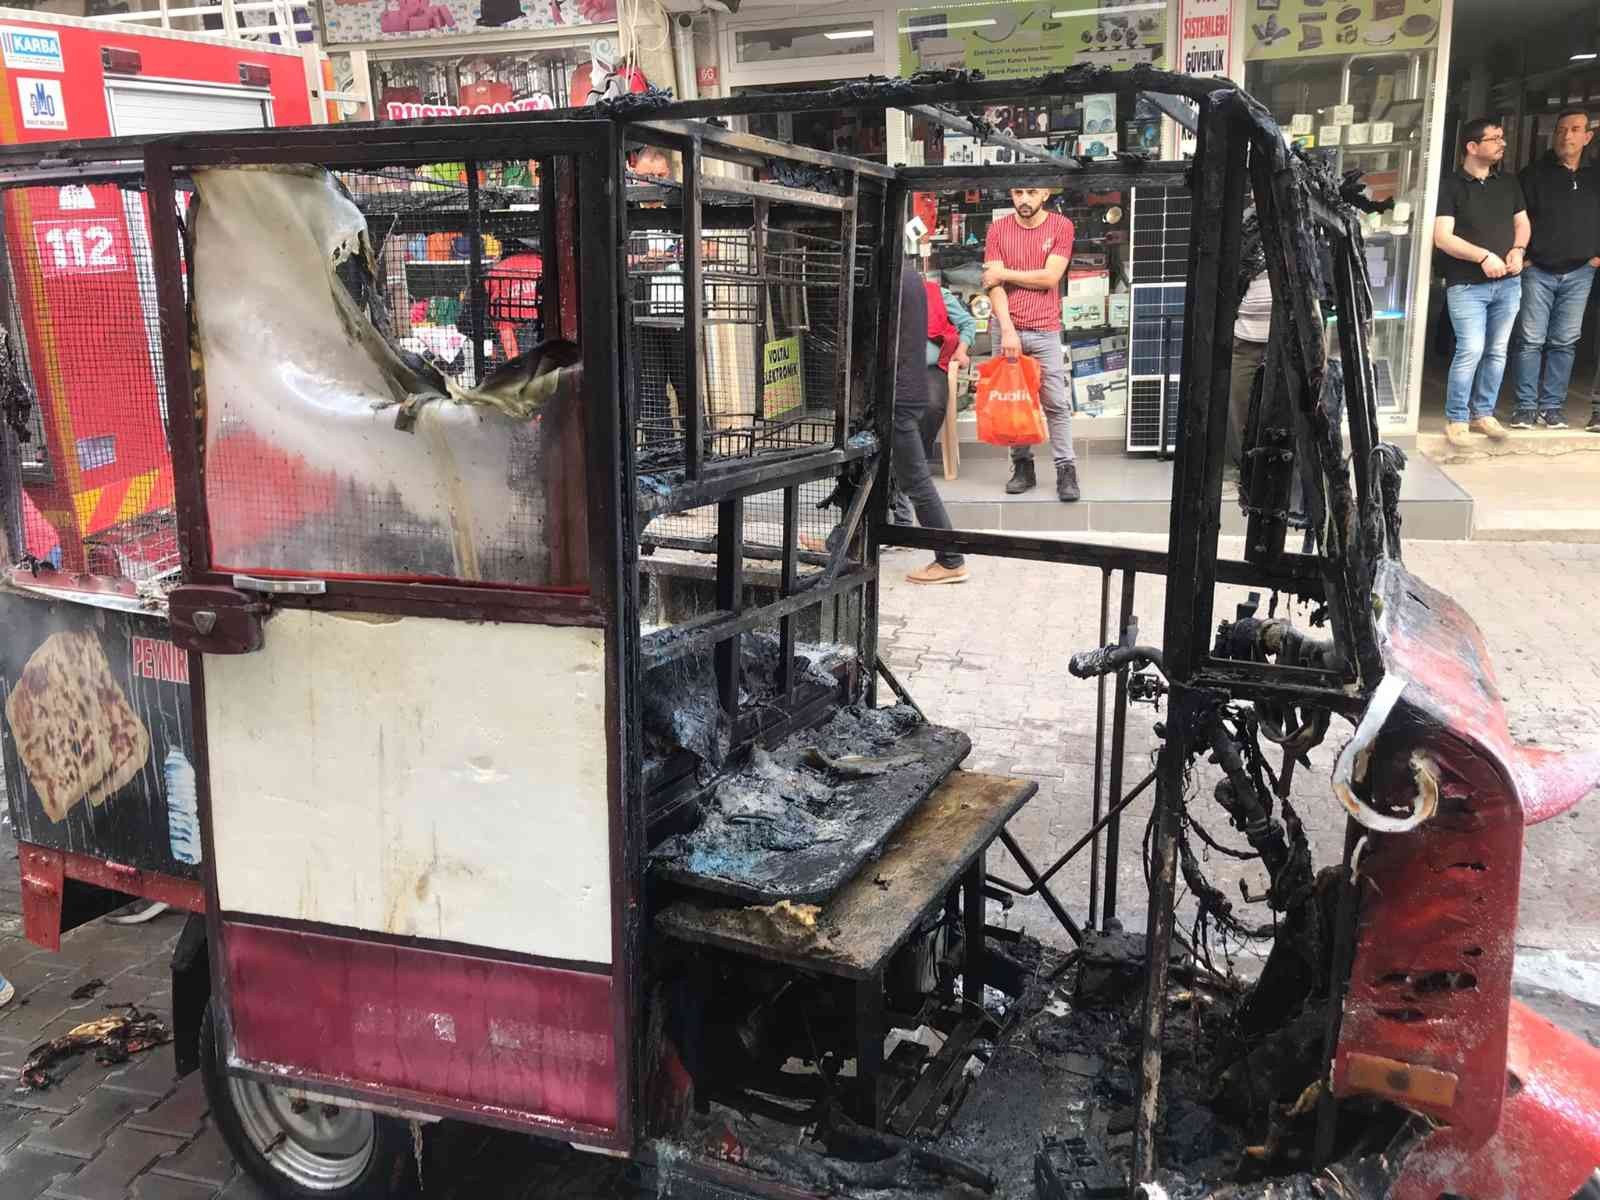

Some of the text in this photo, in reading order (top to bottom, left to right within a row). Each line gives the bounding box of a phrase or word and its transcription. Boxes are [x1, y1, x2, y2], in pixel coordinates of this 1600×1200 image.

[14, 35, 59, 56] KARBA
[46, 226, 117, 269] 112
[767, 346, 790, 364] VOLTAJ
